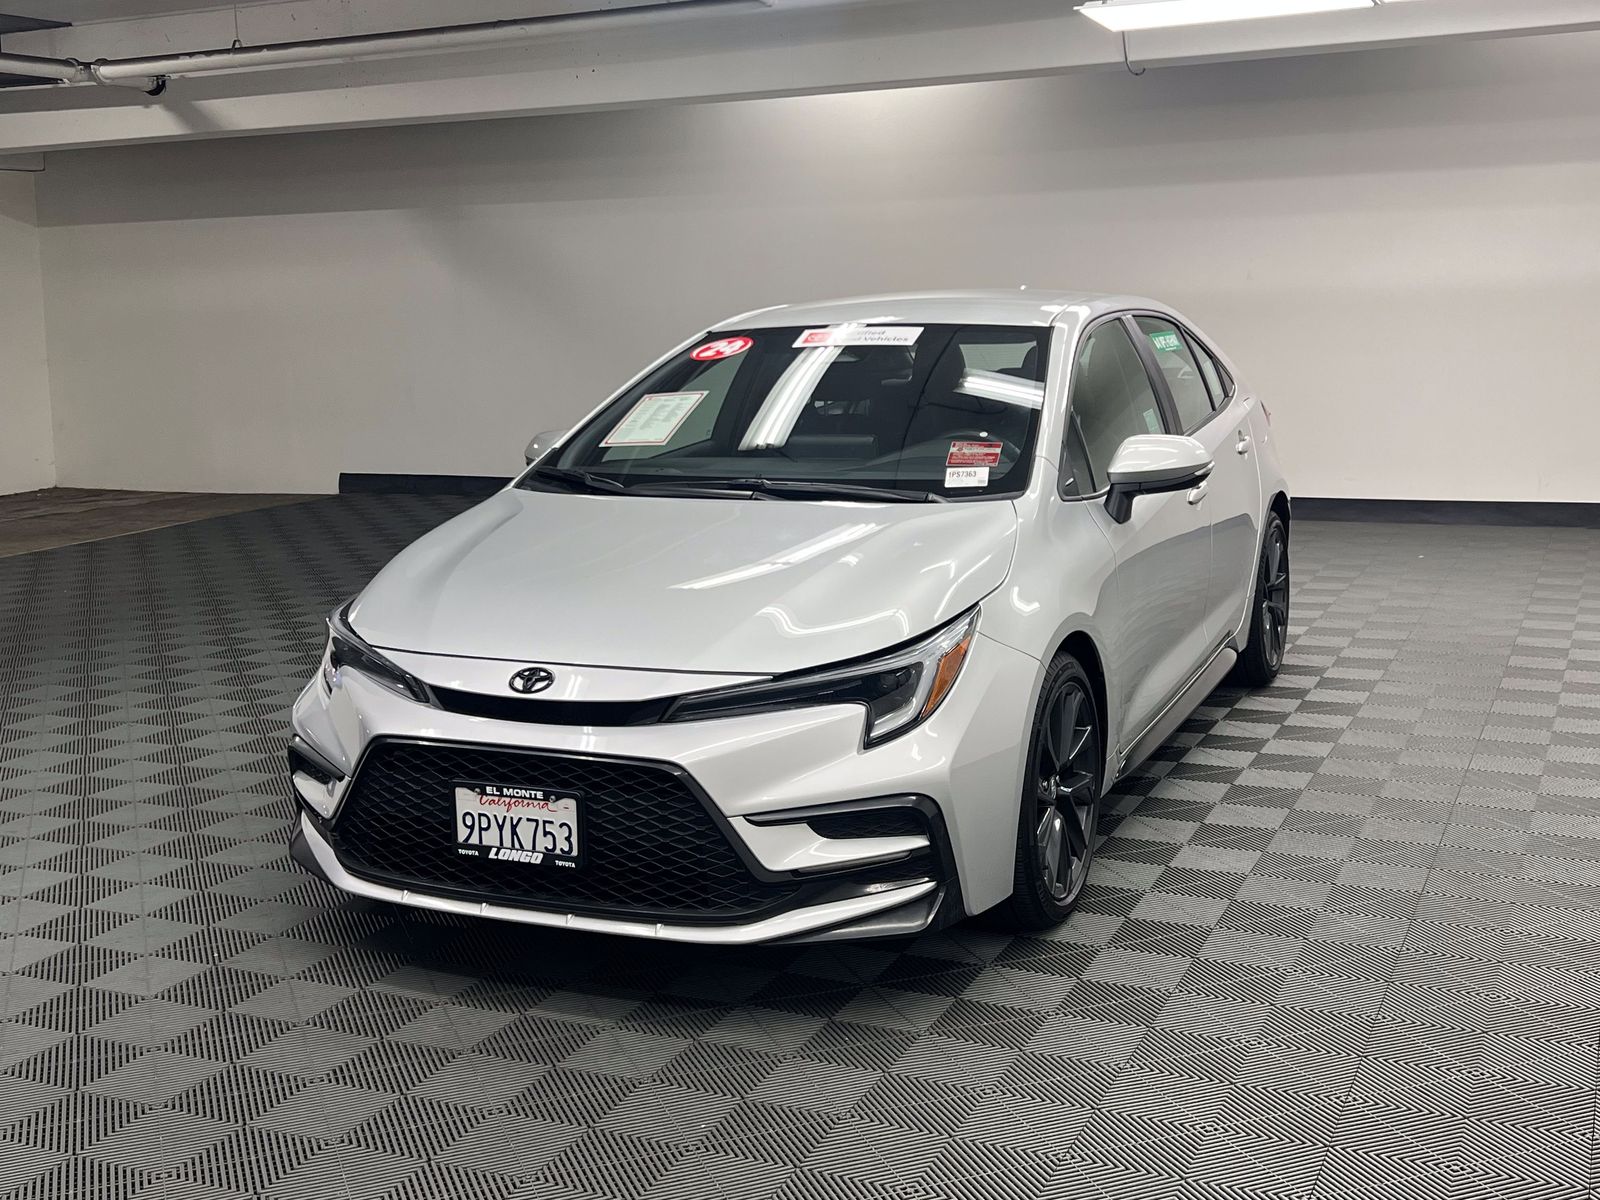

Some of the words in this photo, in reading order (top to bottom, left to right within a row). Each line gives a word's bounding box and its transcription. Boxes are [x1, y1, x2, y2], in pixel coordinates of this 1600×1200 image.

[485, 786, 500, 795] EL
[503, 788, 544, 799] MONTE
[480, 794, 557, 812] California
[462, 811, 573, 855] 9PYK753
[458, 848, 479, 856] TOYOTA
[488, 847, 544, 864] LONGO
[555, 860, 576, 868] TOYOTA
